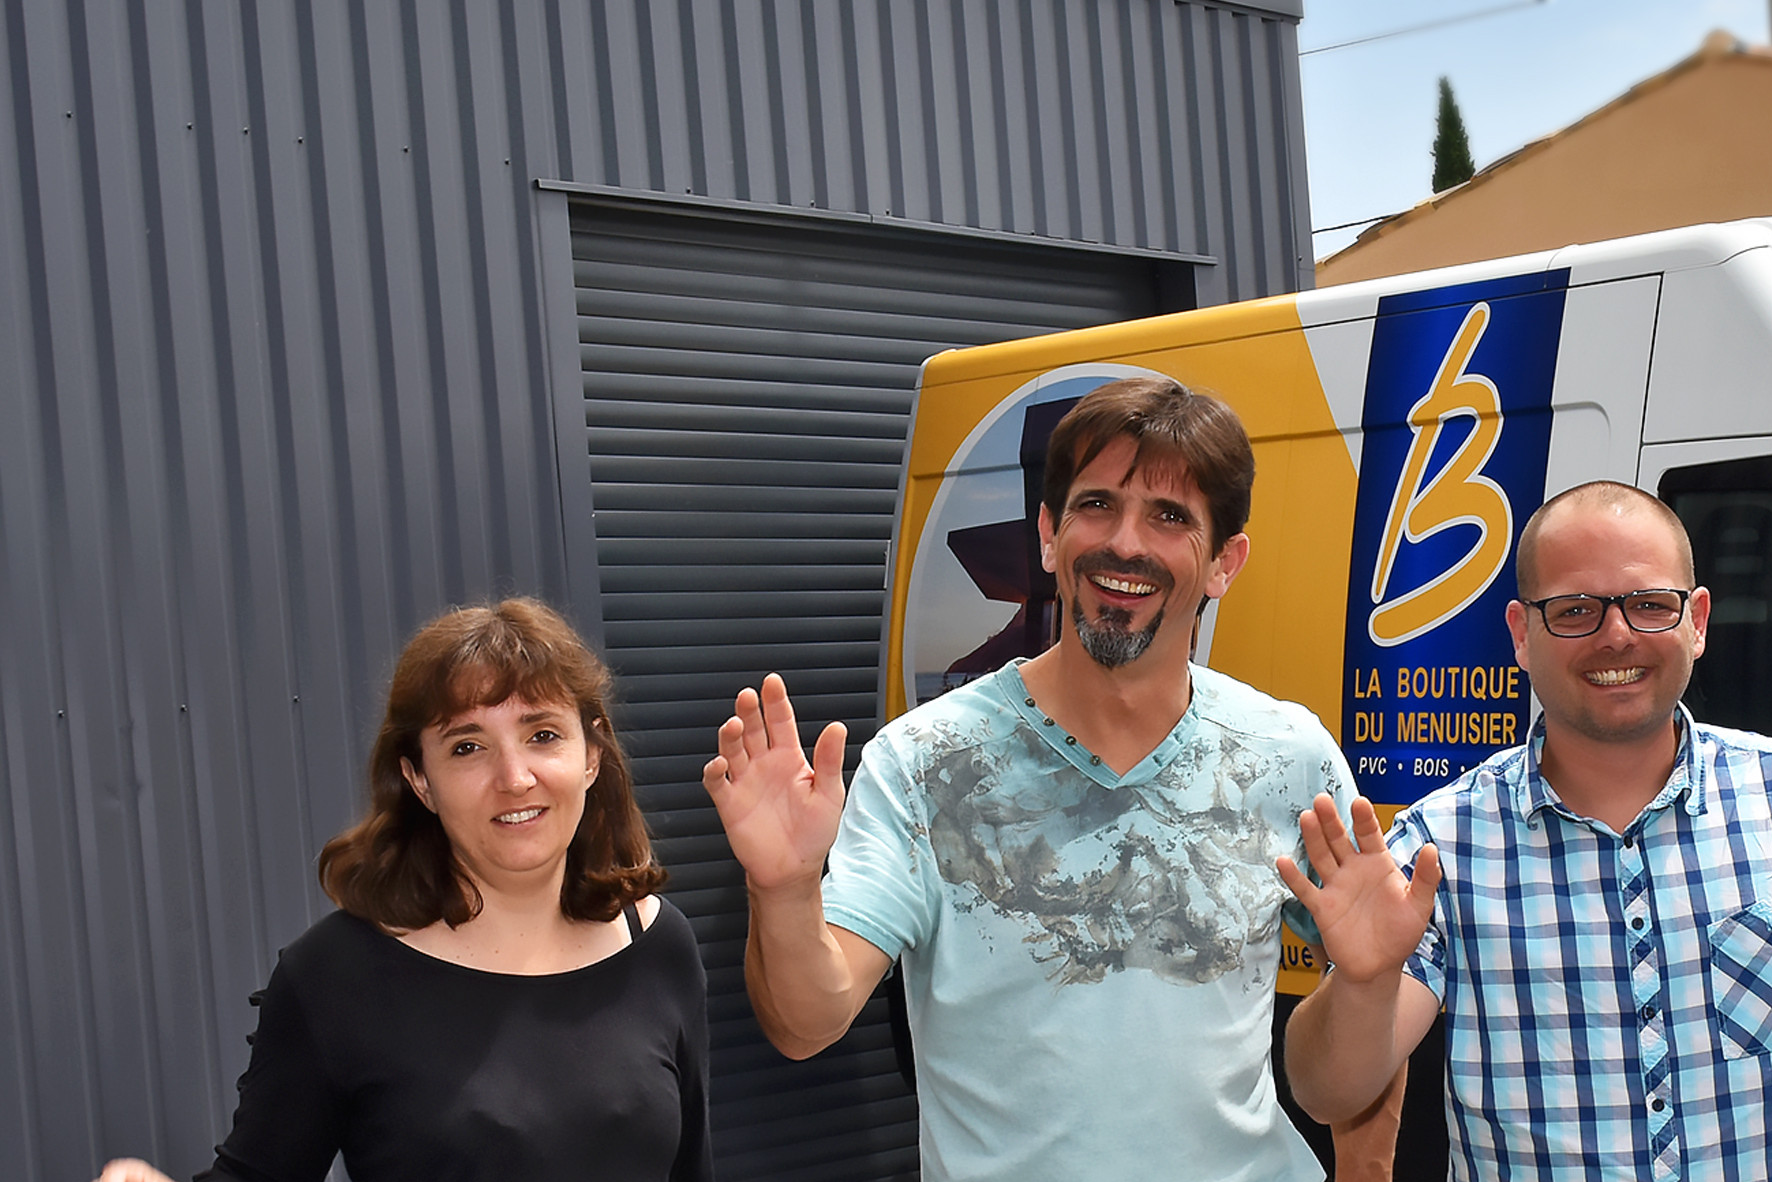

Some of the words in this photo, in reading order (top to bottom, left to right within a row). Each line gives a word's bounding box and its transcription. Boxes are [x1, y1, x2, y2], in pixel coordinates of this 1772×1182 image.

[1354, 667, 1382, 699] LA
[1397, 666, 1520, 701] BOUTIQUE
[1354, 711, 1384, 743] DU
[1397, 711, 1517, 745] MENUISIER
[1358, 756, 1388, 775] PVC
[1413, 757, 1450, 777] BOIS
